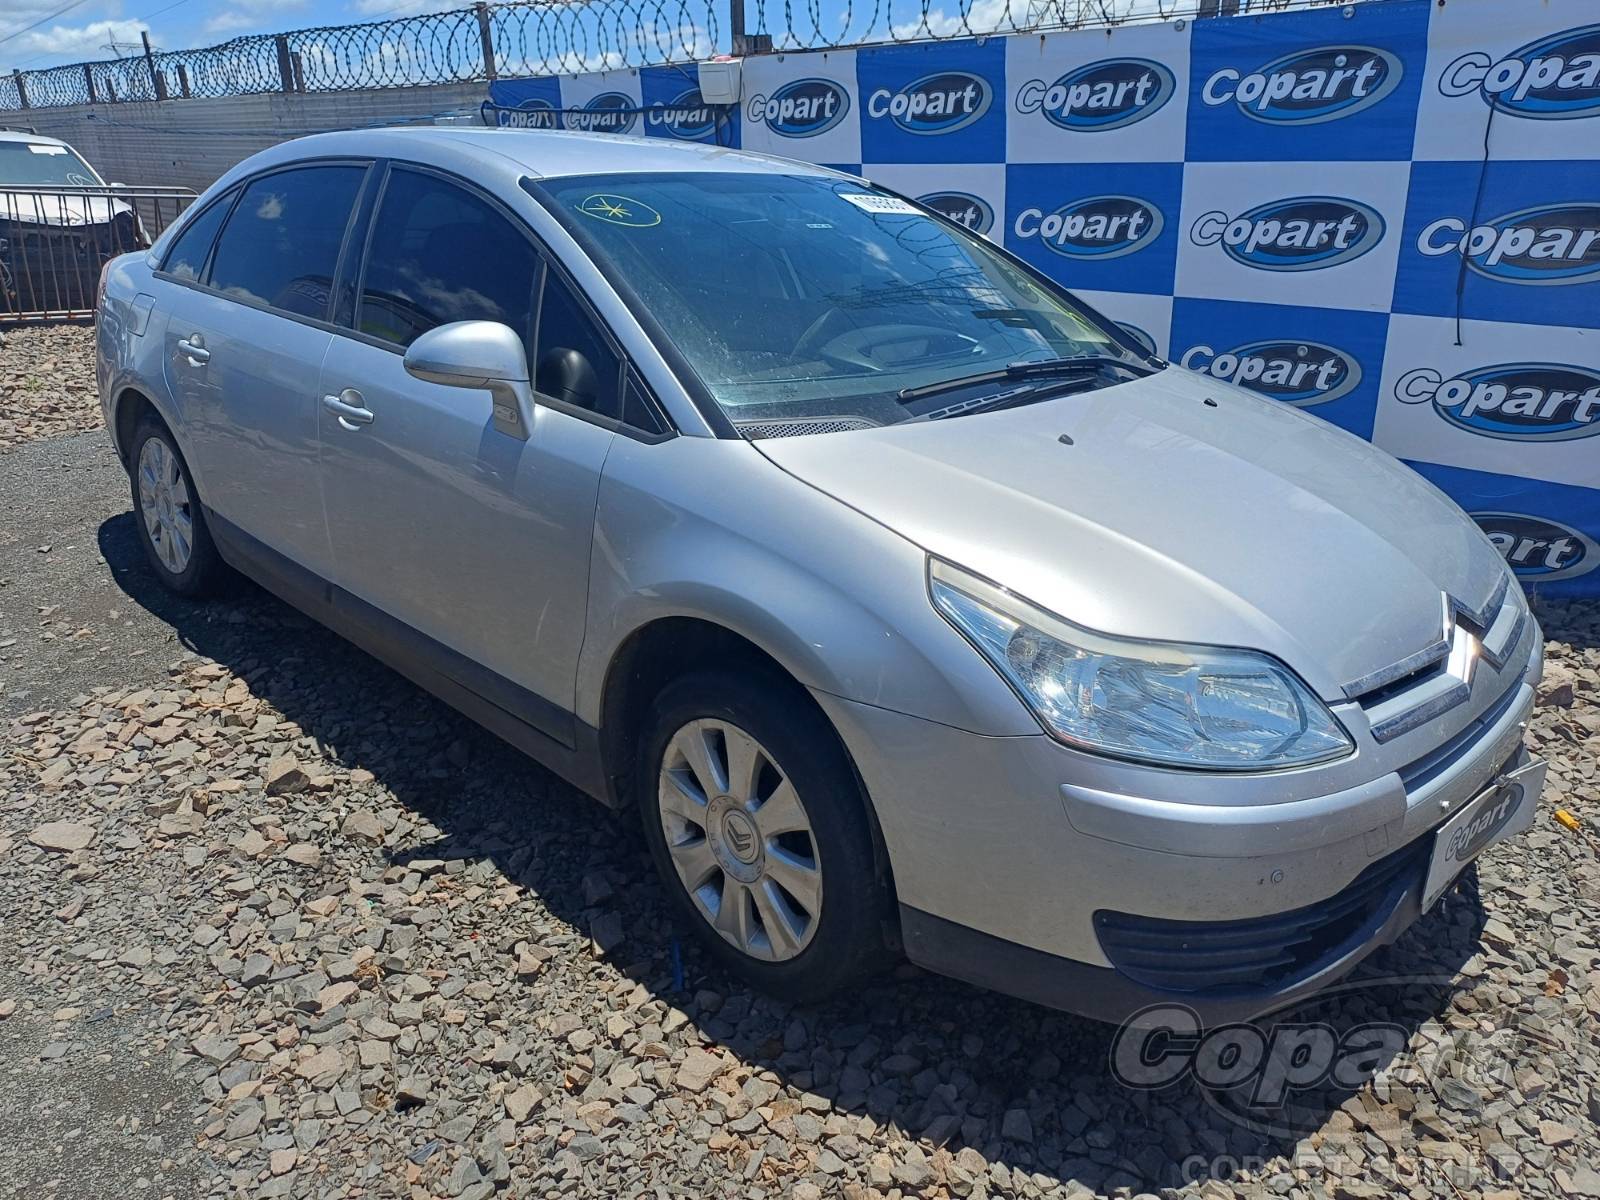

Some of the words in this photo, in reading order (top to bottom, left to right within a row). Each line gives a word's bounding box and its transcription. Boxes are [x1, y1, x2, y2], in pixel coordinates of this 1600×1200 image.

[1015, 72, 1152, 118] Copart
[1202, 59, 1381, 112] Copart
[1438, 51, 1600, 102] Copa
[498, 109, 552, 128] Copart
[566, 103, 627, 131] Copart
[649, 102, 716, 129] Copar
[747, 91, 835, 126] Copart
[868, 83, 977, 122] Copart
[1015, 208, 1148, 242] Copart
[1190, 210, 1359, 254] Copart
[1416, 217, 1600, 267] Copar
[1180, 345, 1338, 391] Copart
[1394, 367, 1600, 424] Copart
[1486, 531, 1574, 569] art
[1445, 795, 1512, 861] Copart
